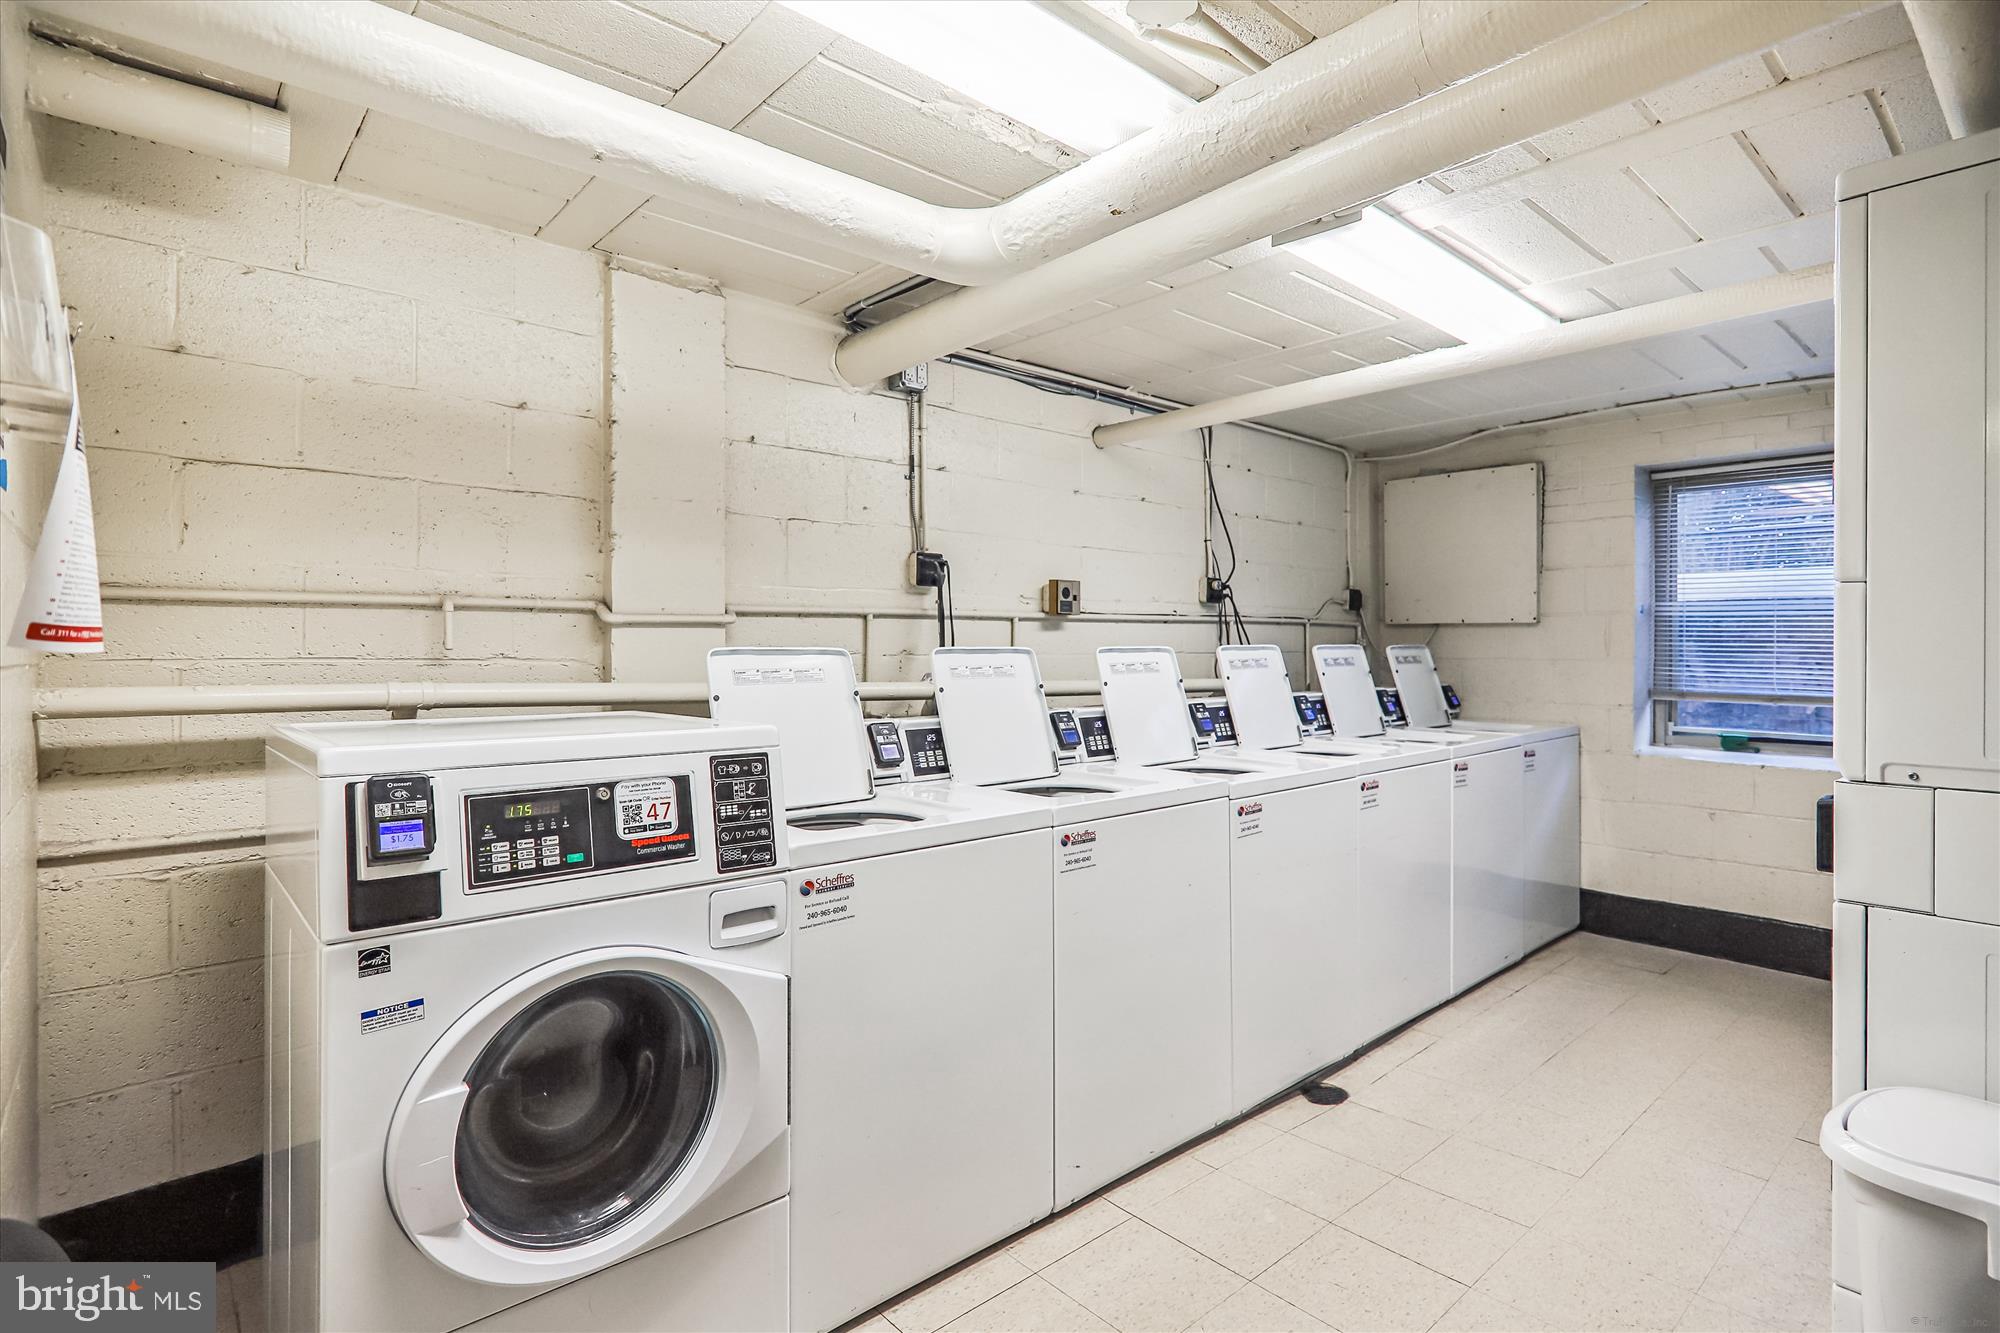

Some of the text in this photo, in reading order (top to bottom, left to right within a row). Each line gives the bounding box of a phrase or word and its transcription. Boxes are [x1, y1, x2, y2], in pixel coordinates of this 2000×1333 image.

[646, 802, 671, 820] 47
[391, 833, 414, 844] $1.75
[637, 844, 667, 854] Commercial
[815, 873, 855, 889] Scheffres
[807, 905, 848, 920] 240-965-6040
[377, 1003, 409, 1015] NOTICE
